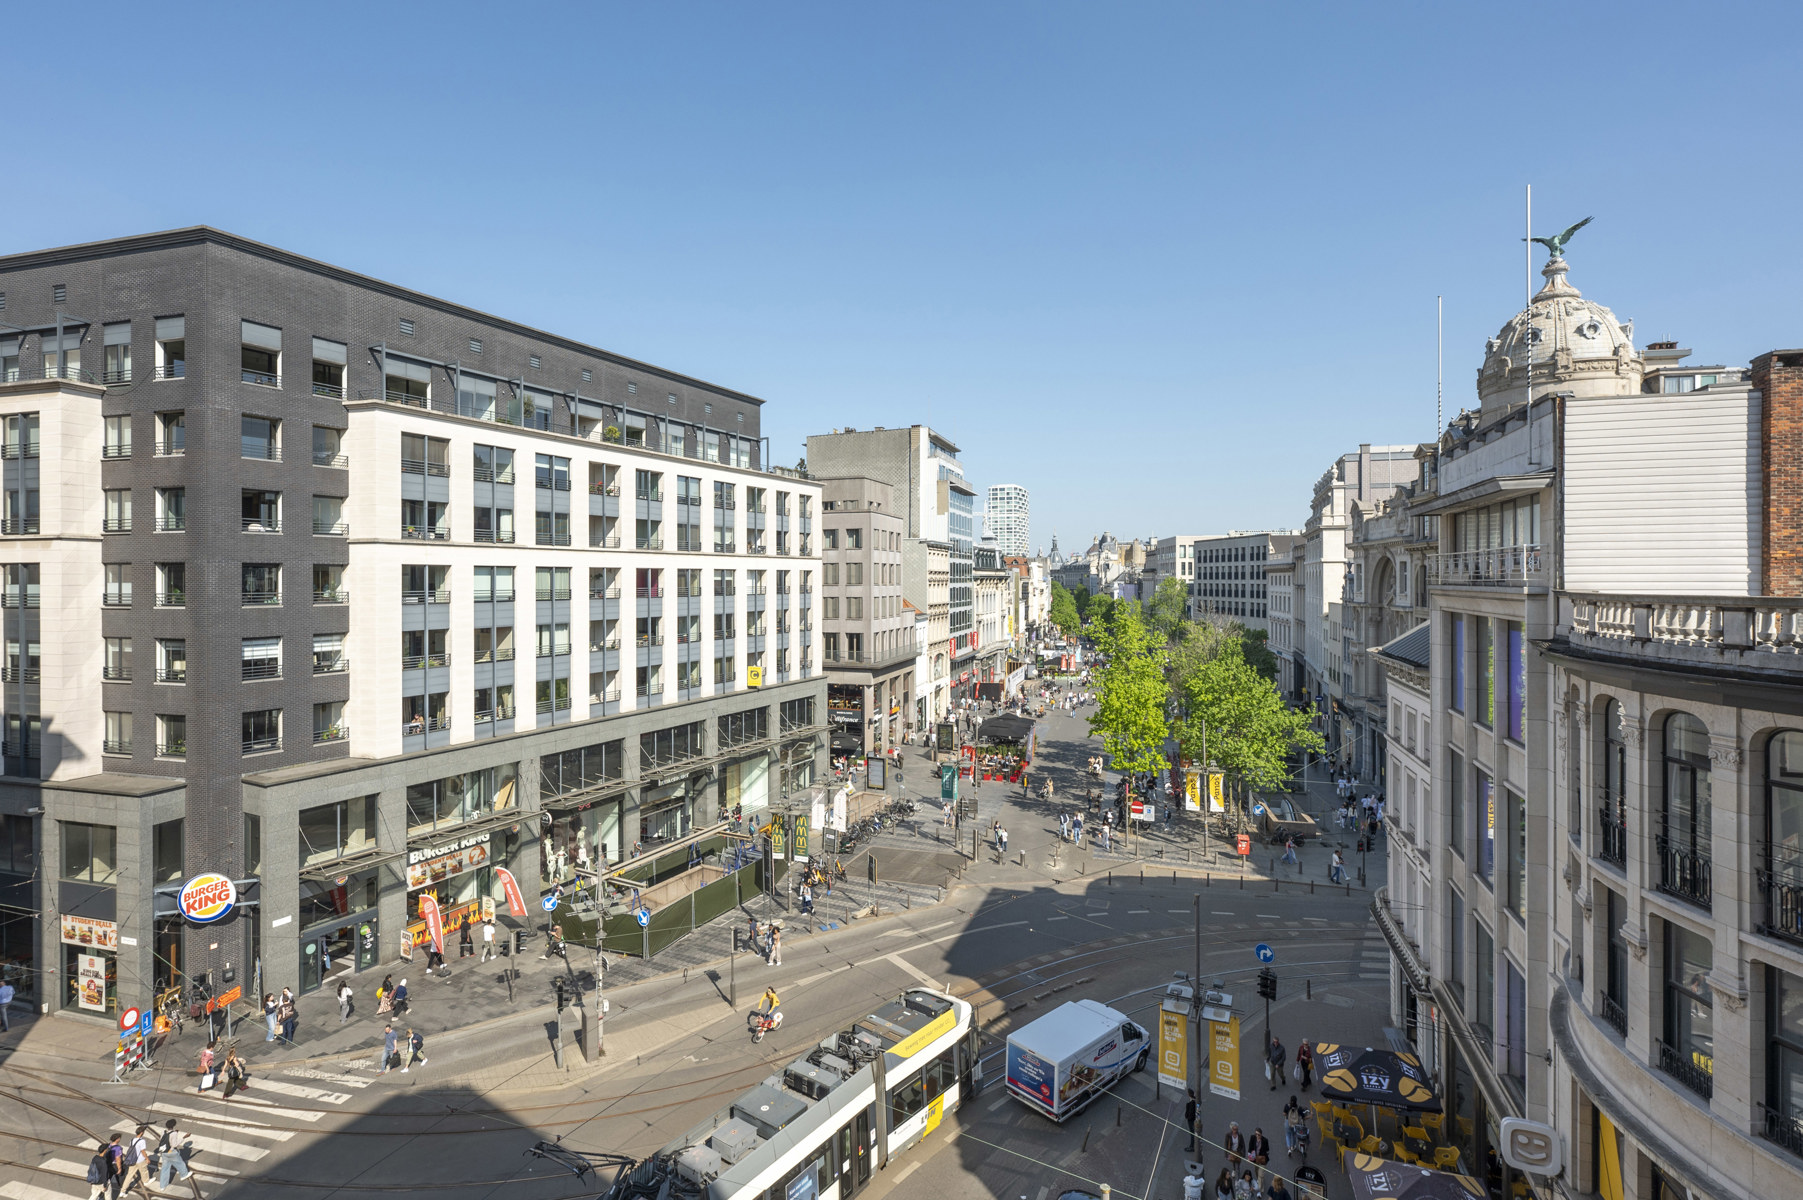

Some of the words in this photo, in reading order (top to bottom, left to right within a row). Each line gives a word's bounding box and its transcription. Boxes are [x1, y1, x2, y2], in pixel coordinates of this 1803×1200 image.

[410, 844, 459, 864] BURGER
[461, 834, 490, 848] KING
[420, 857, 445, 868] STUDENT
[446, 851, 463, 861] DEALS
[184, 880, 228, 903] BURGER
[186, 888, 230, 915] KING
[71, 916, 95, 926] STUDENT
[95, 919, 113, 929] DEALS
